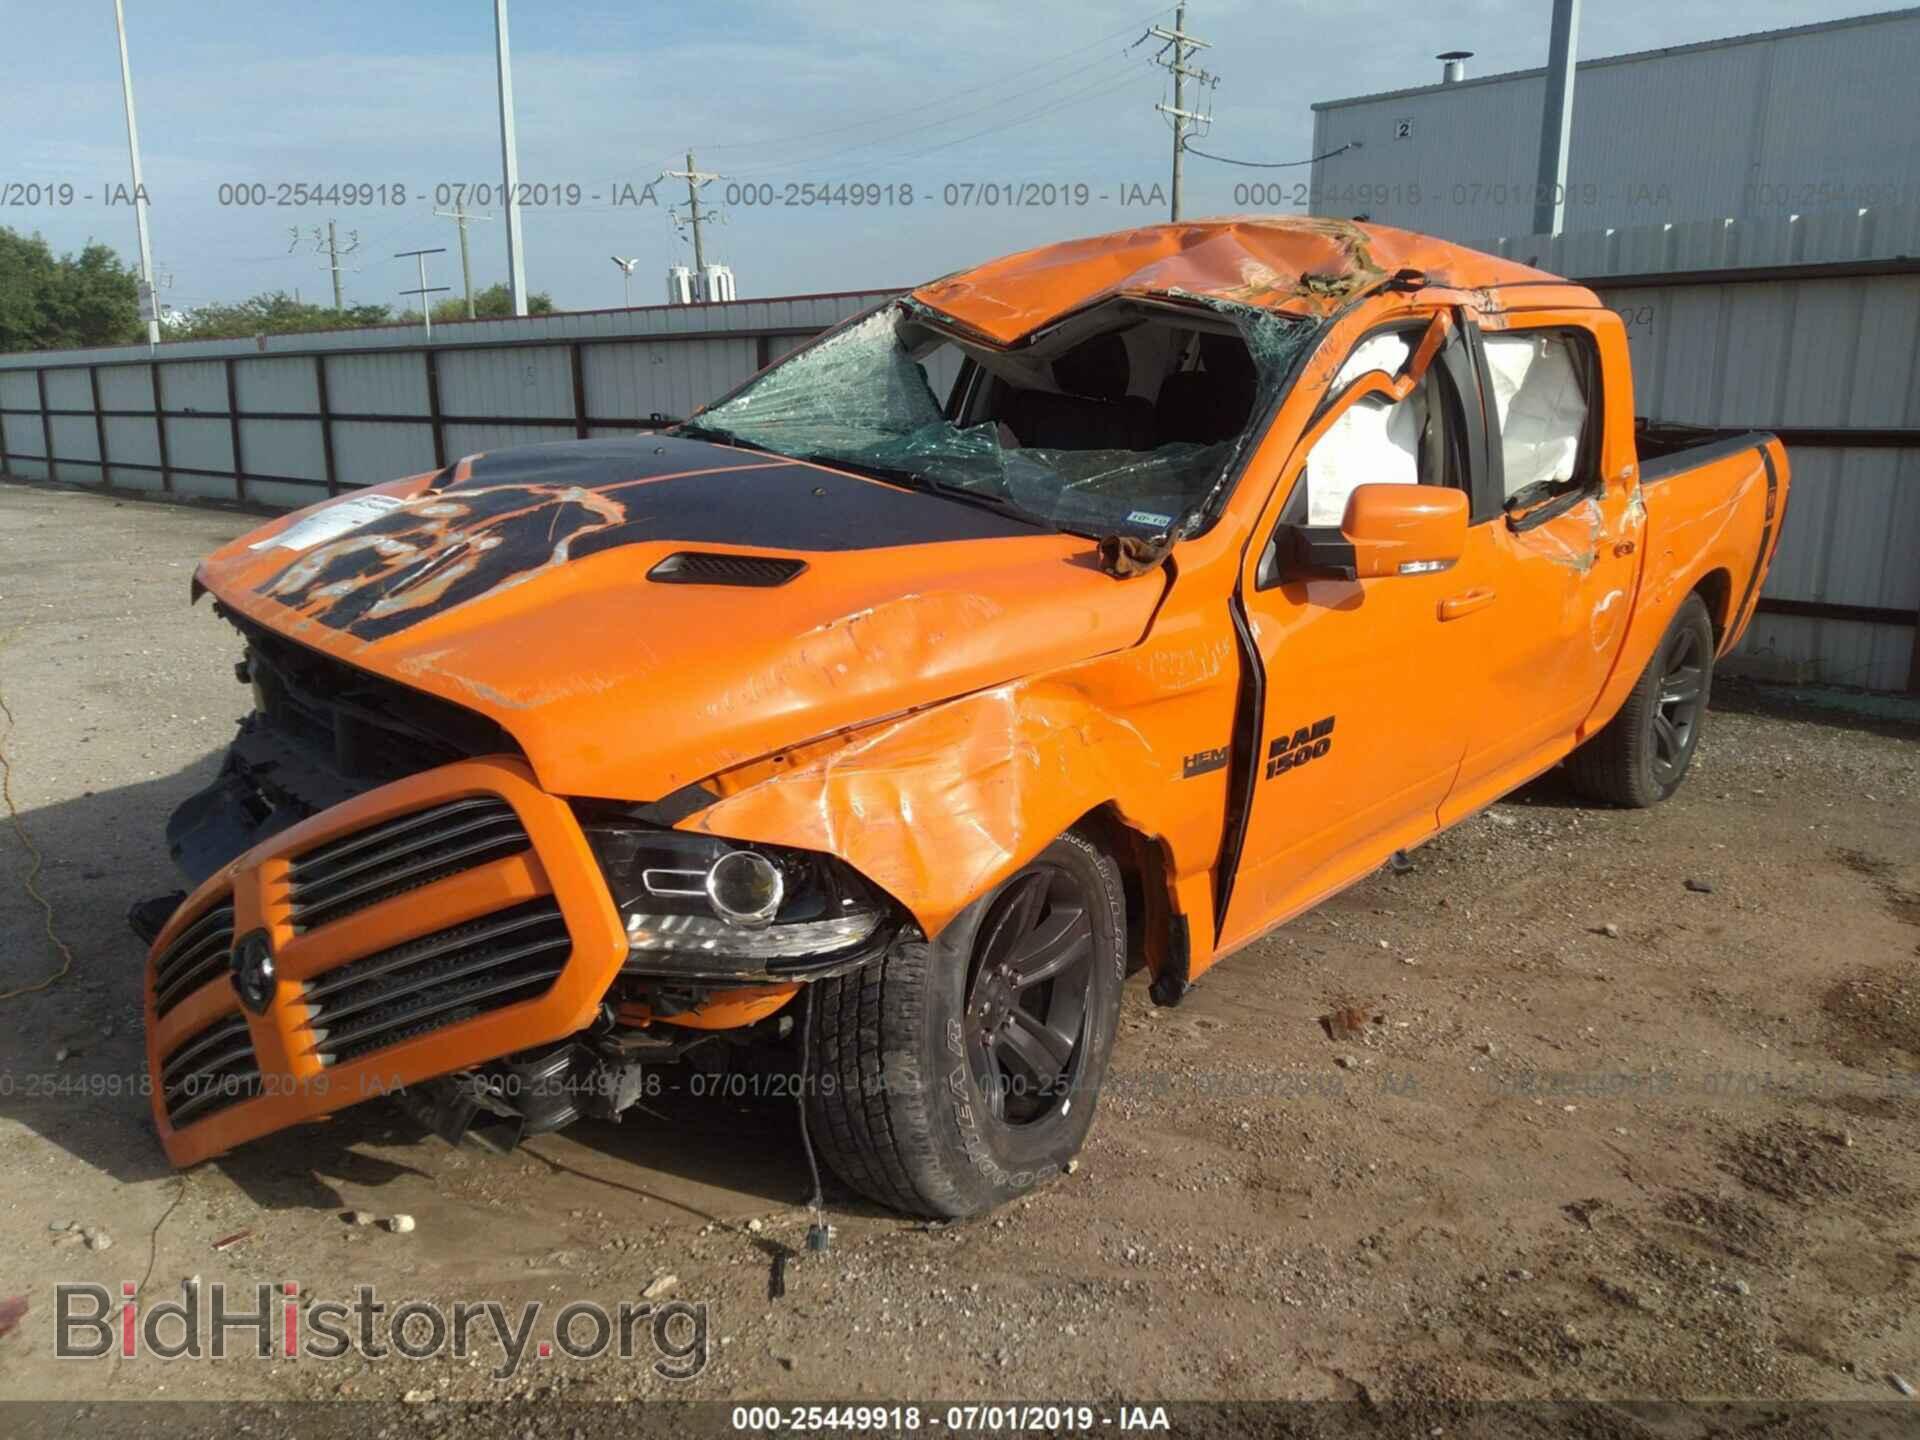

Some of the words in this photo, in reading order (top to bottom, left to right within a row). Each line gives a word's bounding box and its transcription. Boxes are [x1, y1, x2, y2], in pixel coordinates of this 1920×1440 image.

[1399, 123, 1409, 137] 2
[1265, 737, 1332, 781] 1500
[1268, 715, 1336, 760] RAM
